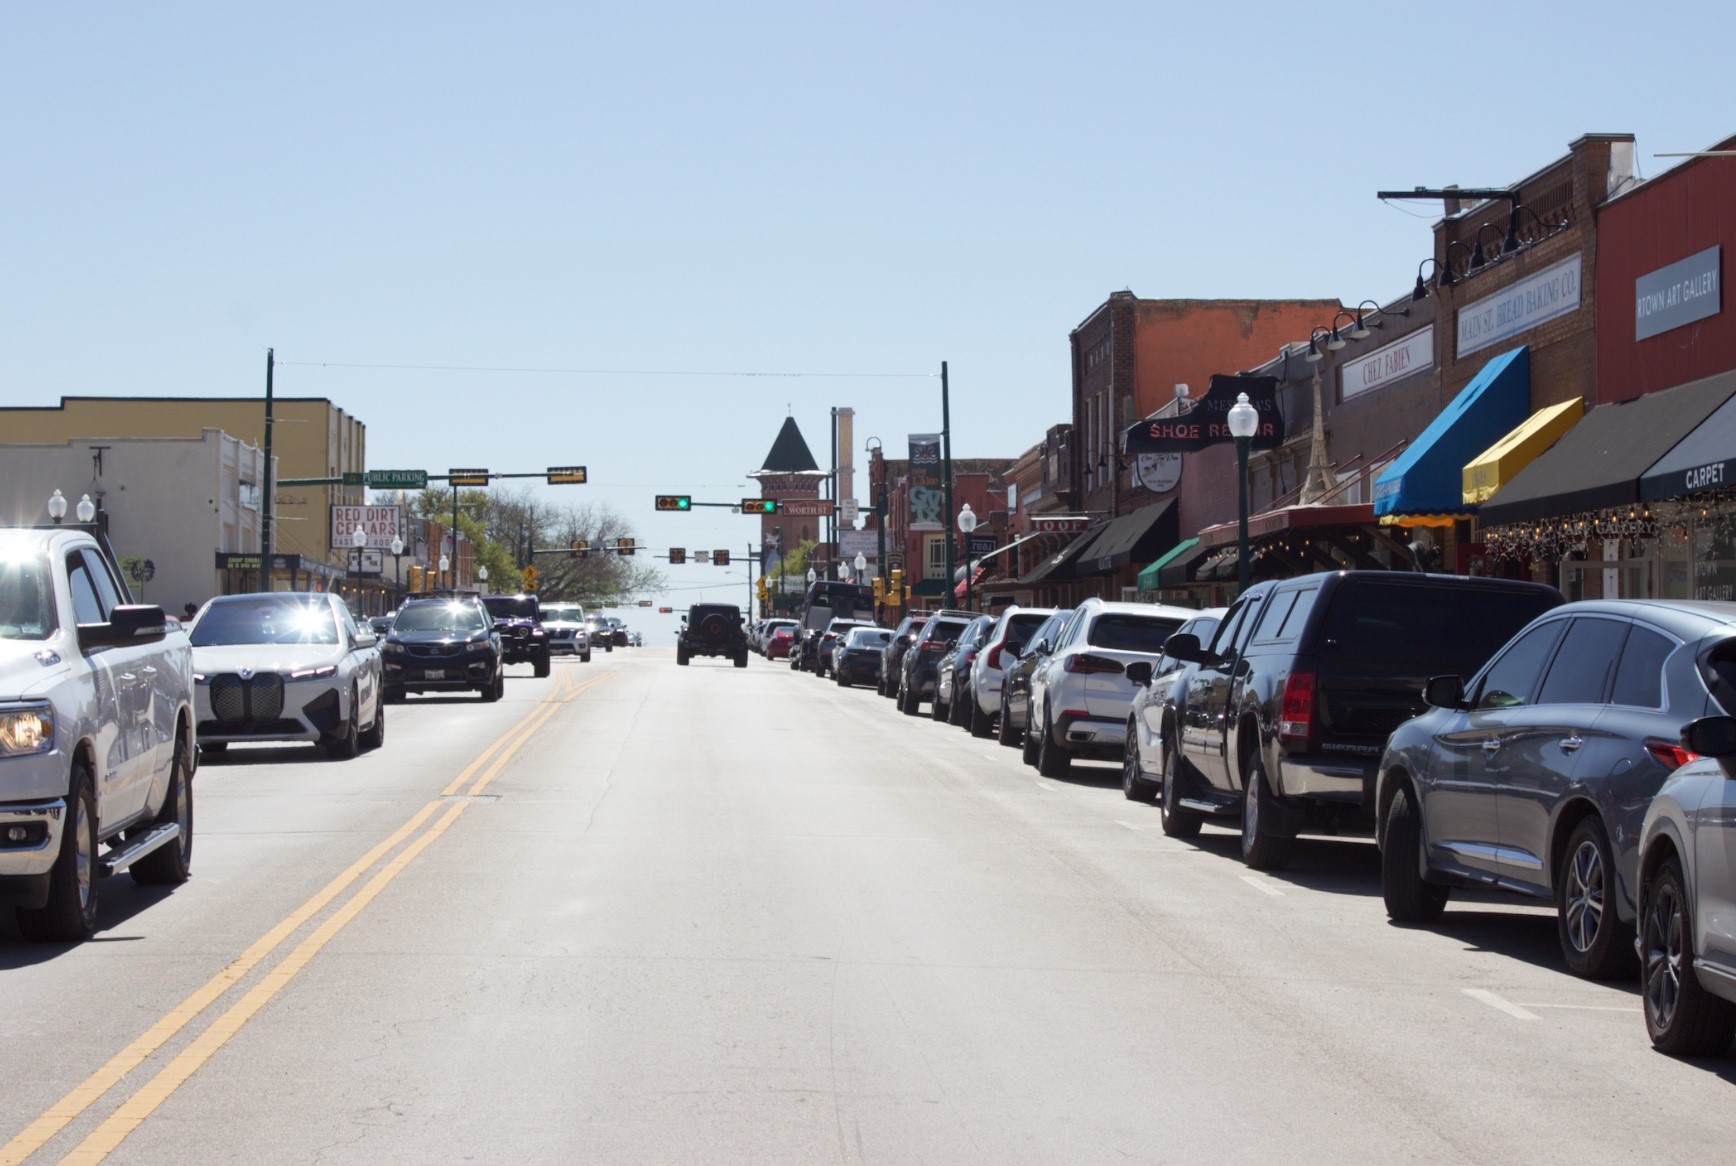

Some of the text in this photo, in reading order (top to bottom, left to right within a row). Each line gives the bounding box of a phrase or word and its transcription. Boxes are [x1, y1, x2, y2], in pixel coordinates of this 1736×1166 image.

[1667, 284, 1681, 308] ART
[1683, 269, 1717, 302] GALLERY
[1460, 269, 1577, 343] MAIN ST. BREAD BAKING CO.
[1363, 345, 1411, 385] CHEZ FABIEN
[1150, 423, 1274, 438] SHOE REIR
[363, 472, 425, 481] PUBLIC PARKING
[1686, 463, 1724, 489] CARPET
[336, 508, 396, 521] RED DIRT
